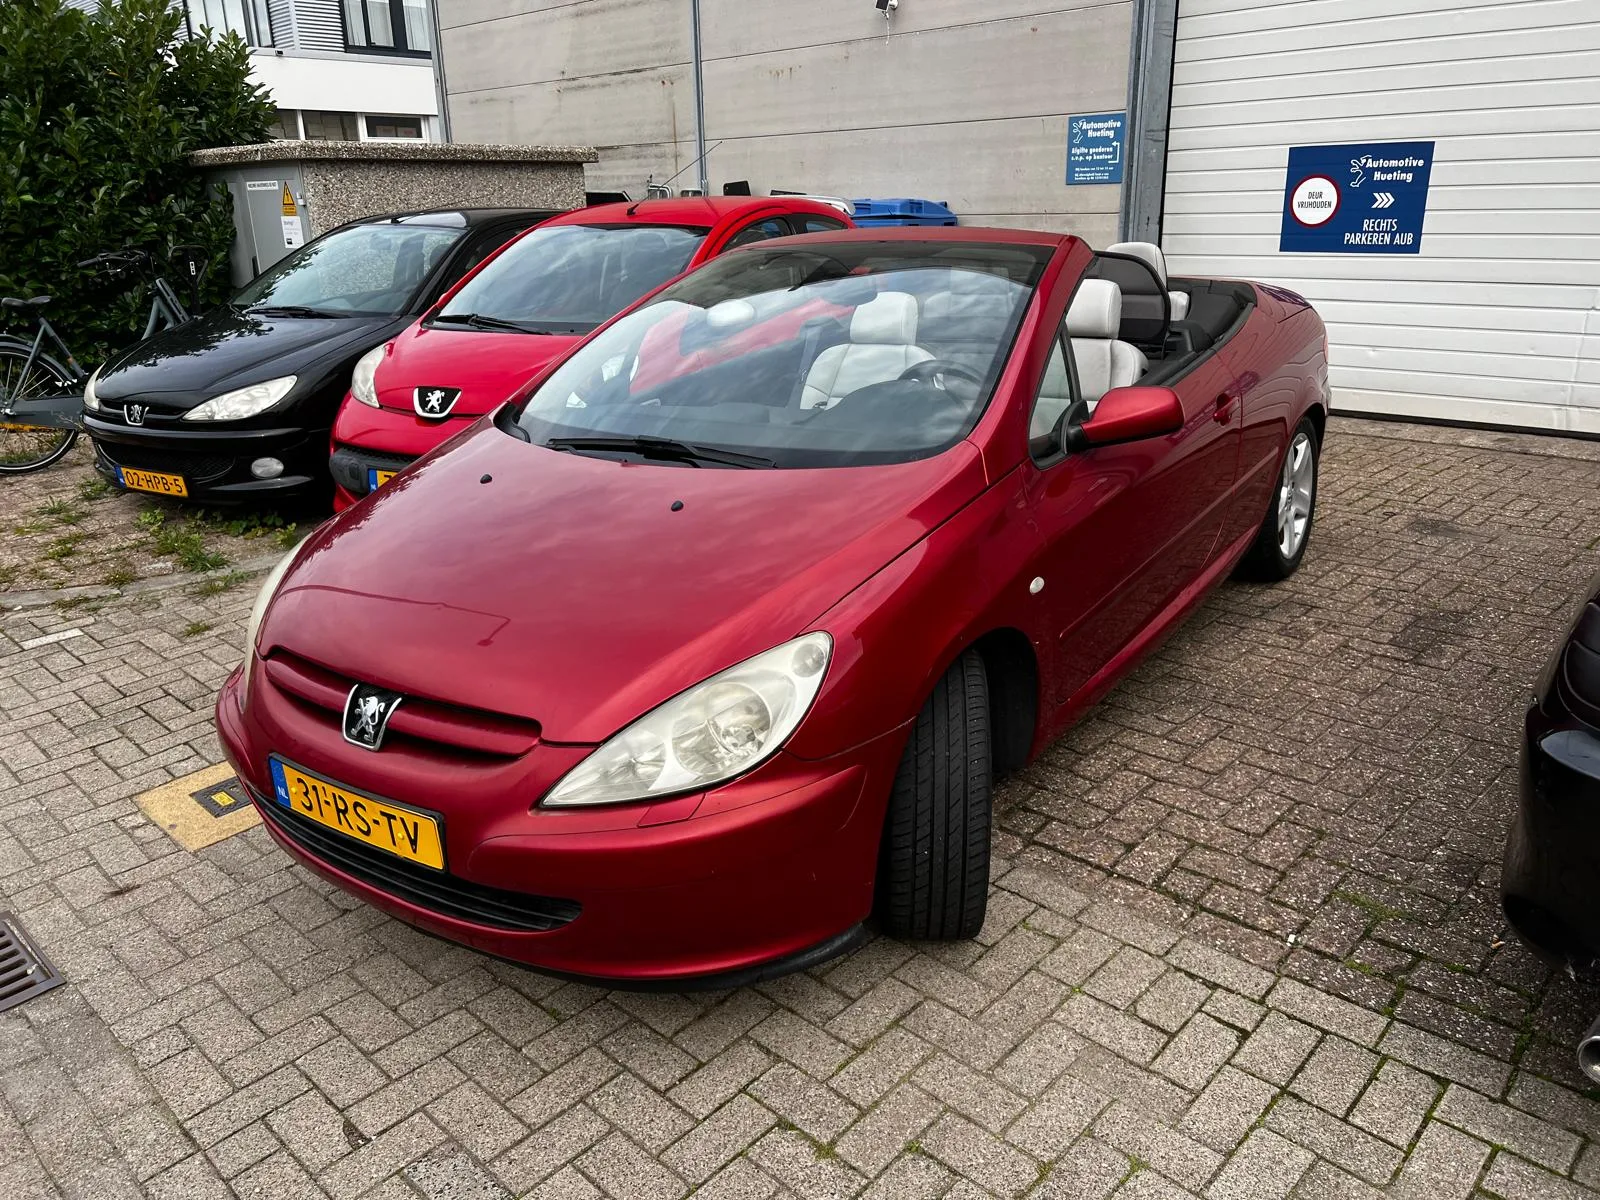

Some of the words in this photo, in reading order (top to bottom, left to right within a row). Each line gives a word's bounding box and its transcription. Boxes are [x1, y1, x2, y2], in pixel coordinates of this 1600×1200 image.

[1082, 120, 1121, 130] Automotive
[1087, 129, 1114, 138] Hueting
[1366, 156, 1425, 168] Automotive
[1373, 170, 1413, 182] Hueting
[1307, 191, 1323, 199] DEUR
[1297, 200, 1332, 209] VRIJHOUDEN
[1363, 218, 1398, 231] RECHTS
[1344, 233, 1391, 245] PARKEREN
[1393, 233, 1414, 245] AUB
[125, 470, 183, 494] 02-HPB-5
[296, 777, 419, 854] 31-RS-TV
